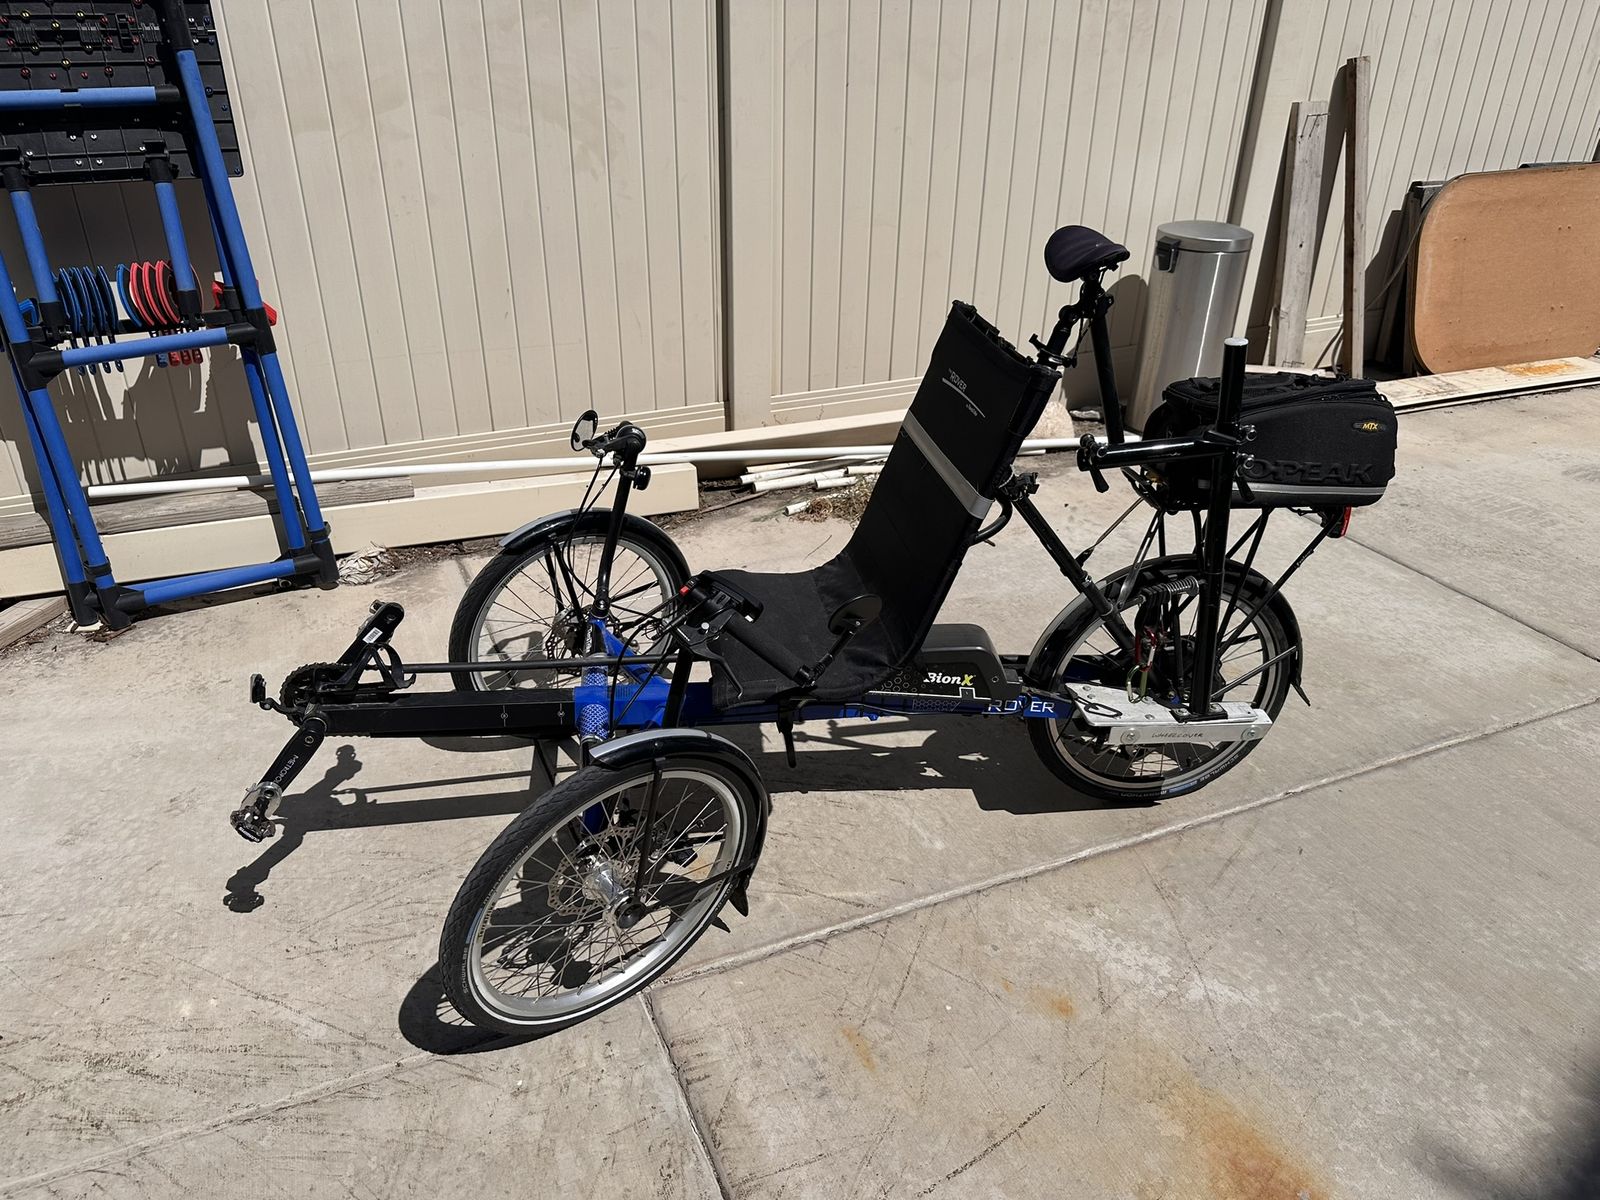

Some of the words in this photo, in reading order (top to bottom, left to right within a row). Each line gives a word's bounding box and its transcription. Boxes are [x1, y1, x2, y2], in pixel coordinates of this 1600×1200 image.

[949, 370, 968, 392] ROVER
[1362, 422, 1379, 430] MTX
[1243, 459, 1373, 484] OPEAK
[923, 672, 973, 686] BionX
[461, 947, 469, 994] SCHWALBE
